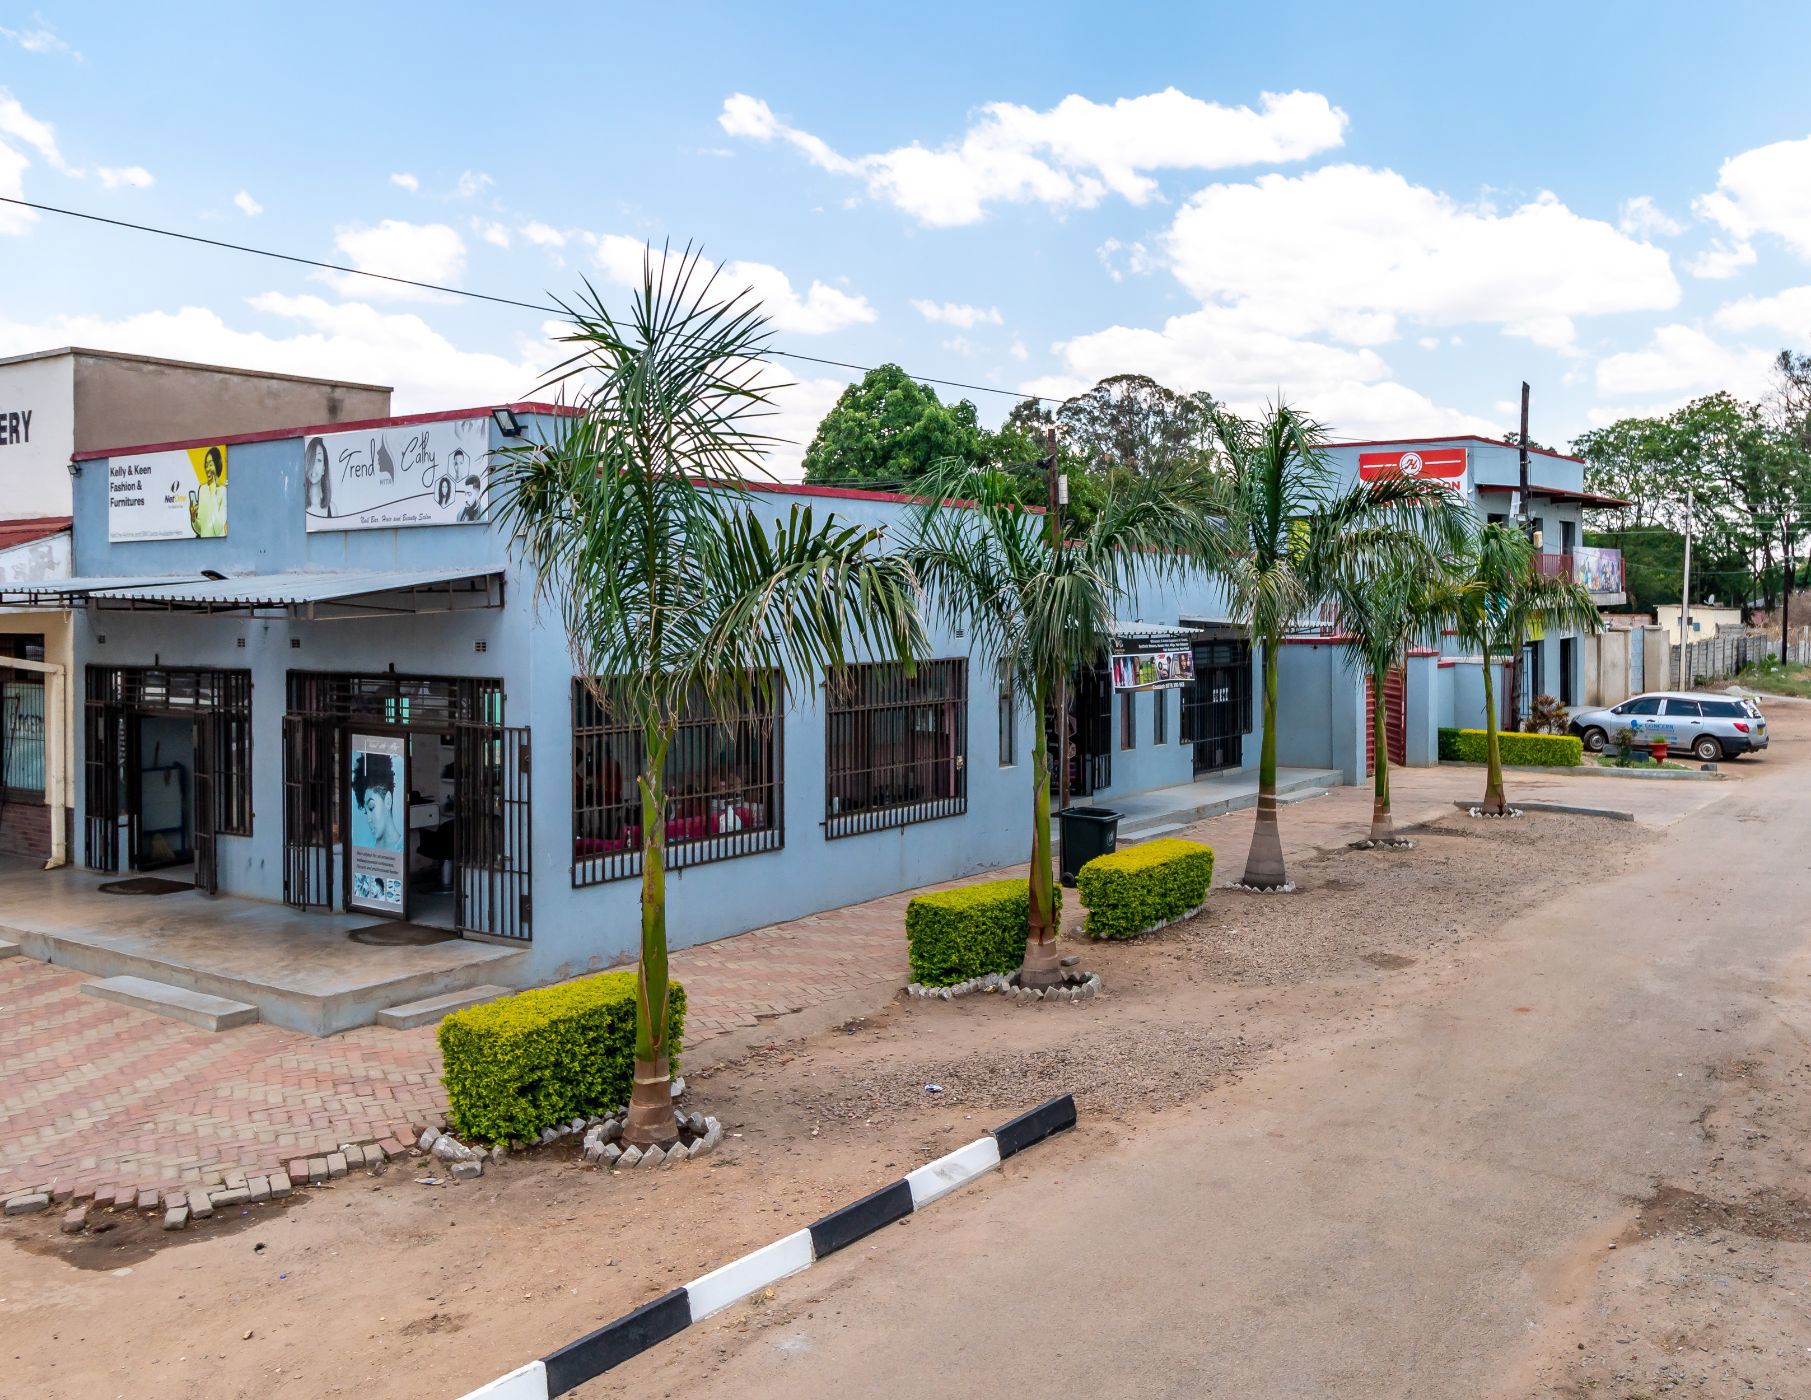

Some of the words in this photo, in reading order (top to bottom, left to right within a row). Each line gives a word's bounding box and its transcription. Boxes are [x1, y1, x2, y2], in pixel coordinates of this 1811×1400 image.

[338, 438, 376, 484] Trend
[401, 431, 439, 488] Cathy
[110, 466, 126, 478] Kelly
[128, 465, 133, 476] &
[134, 465, 152, 475] Keen
[110, 481, 136, 493] Fashion
[137, 480, 142, 491] &
[110, 497, 145, 508] Furnitures
